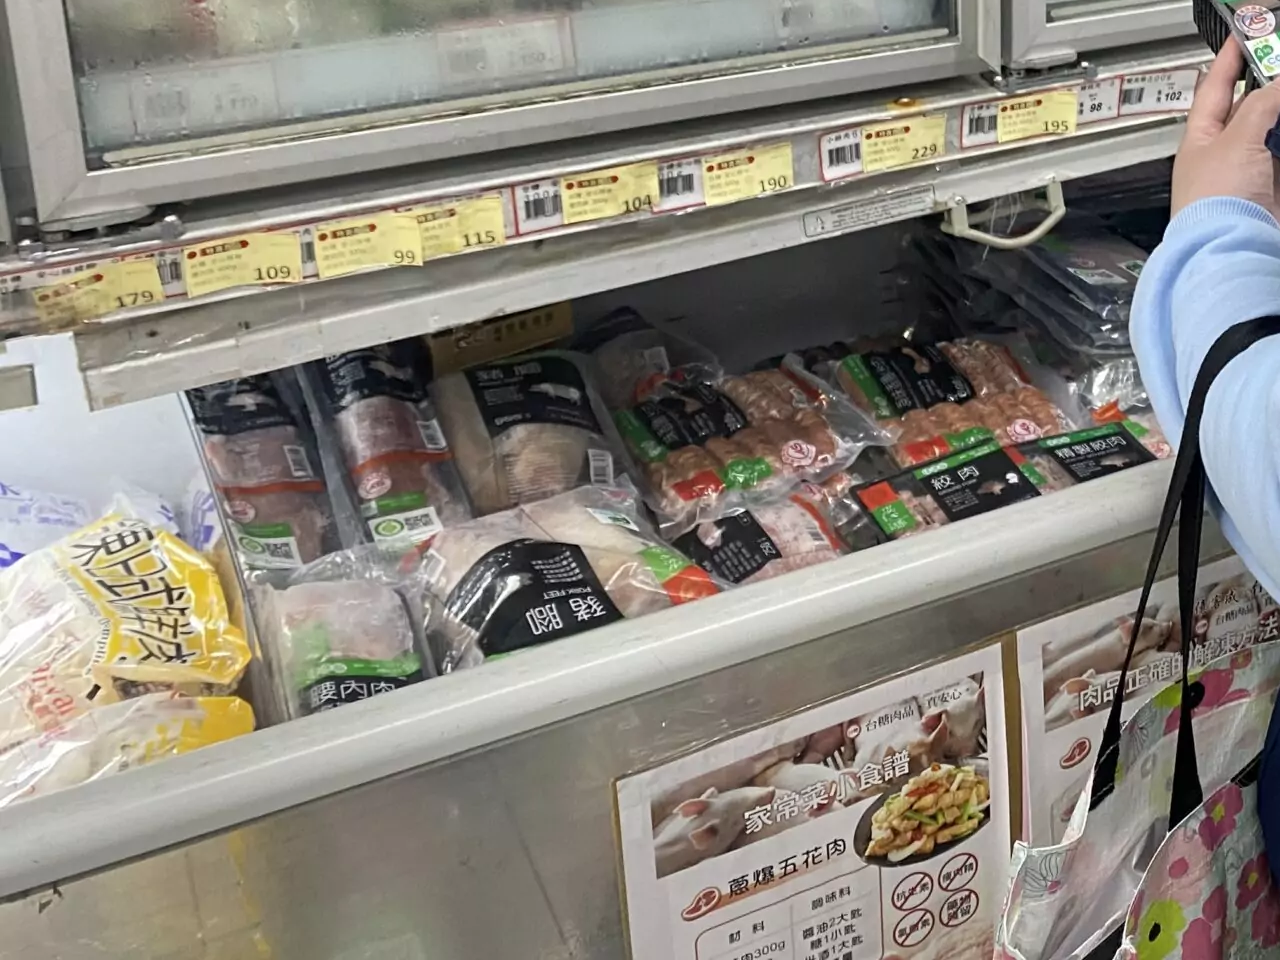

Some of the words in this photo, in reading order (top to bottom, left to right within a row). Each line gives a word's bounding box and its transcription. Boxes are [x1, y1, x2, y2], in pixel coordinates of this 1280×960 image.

[1164, 90, 1183, 102] 102
[1089, 102, 1103, 113] 98
[1042, 119, 1069, 134] 195
[911, 143, 938, 160] 229
[759, 174, 788, 192] 190
[622, 193, 653, 213] 104
[463, 229, 496, 247] 115
[393, 249, 416, 264] 99
[253, 265, 292, 281] 109
[114, 289, 155, 309] 179
[930, 465, 980, 491] 絞肉
[525, 595, 607, 636] 豬腳
[864, 705, 916, 733] 台糖肉品
[743, 749, 912, 835] 家常菜小食譜
[811, 885, 851, 911] 調味料
[802, 907, 863, 940] 醬油2大匙
